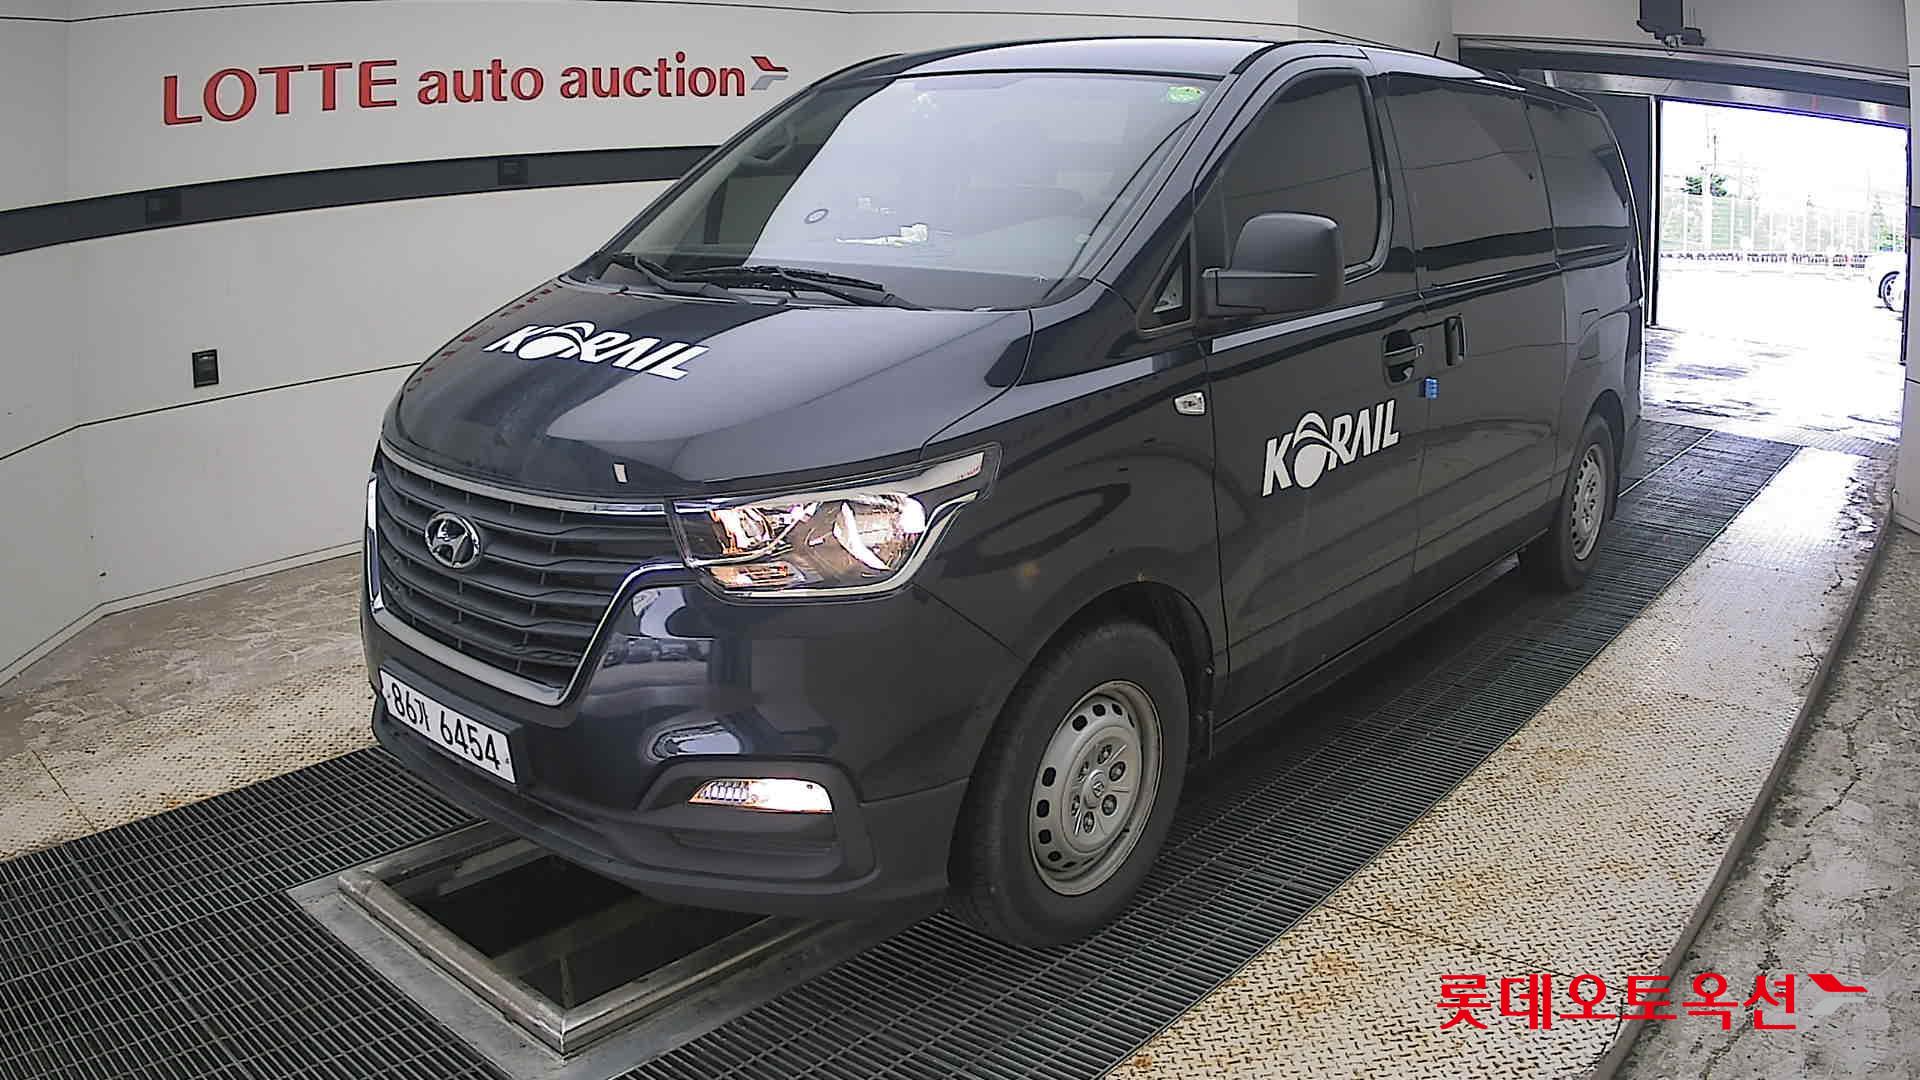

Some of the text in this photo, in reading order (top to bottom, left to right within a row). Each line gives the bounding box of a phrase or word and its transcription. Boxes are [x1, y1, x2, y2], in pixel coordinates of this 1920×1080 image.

[163, 51, 747, 126] LOTTE auto auction
[483, 321, 710, 381] KORAIL
[1262, 399, 1400, 496] KORAIL
[440, 710, 501, 770] 6454
